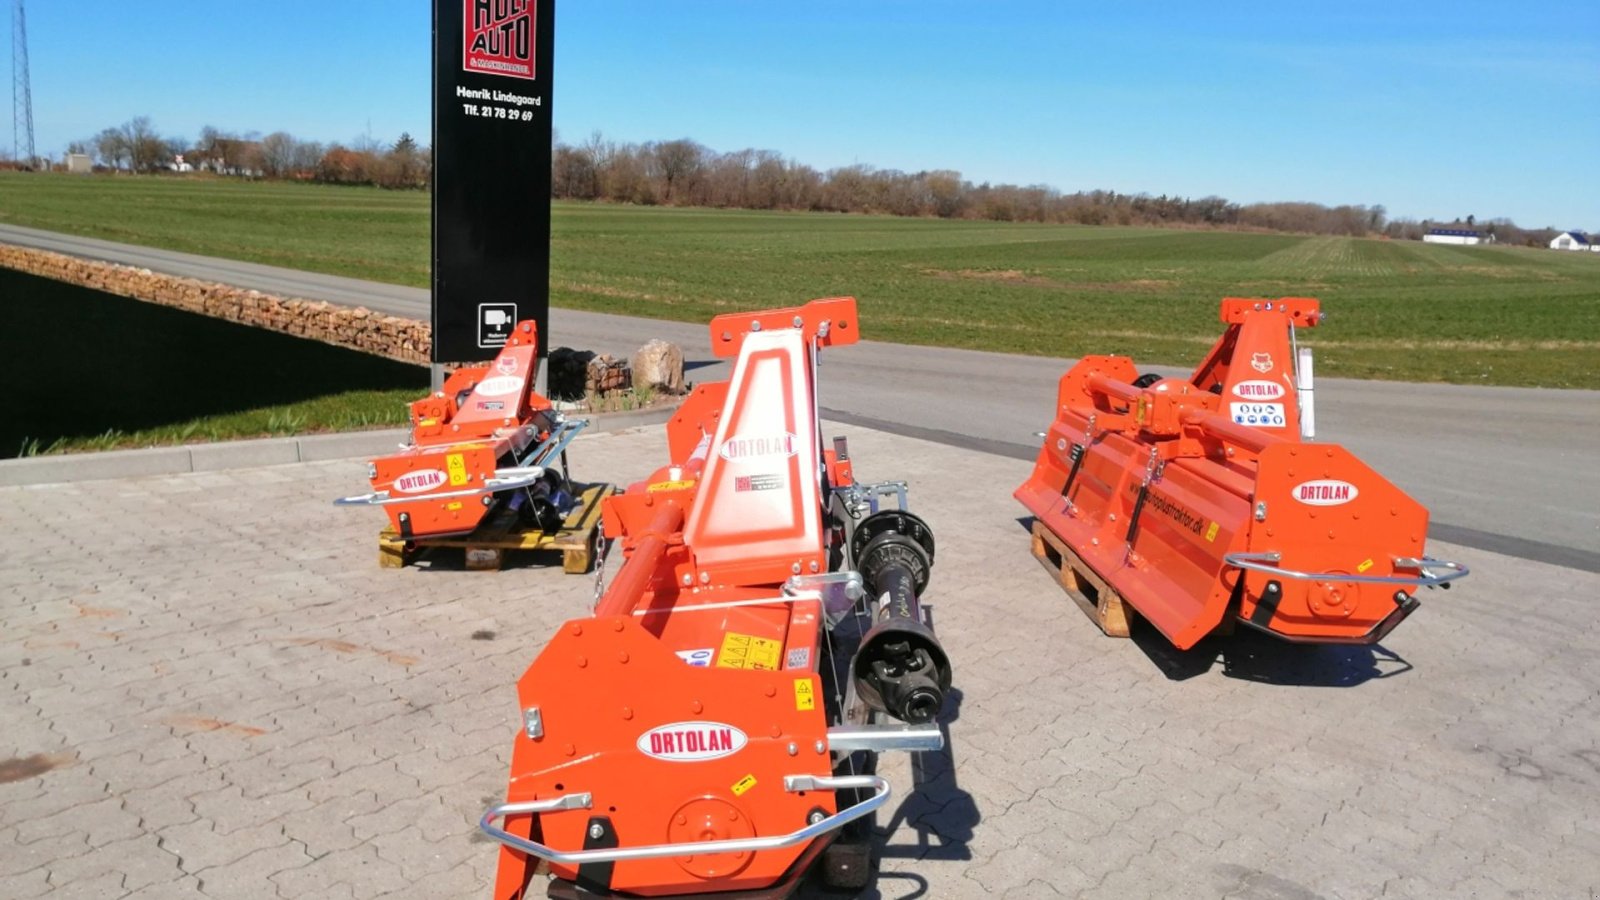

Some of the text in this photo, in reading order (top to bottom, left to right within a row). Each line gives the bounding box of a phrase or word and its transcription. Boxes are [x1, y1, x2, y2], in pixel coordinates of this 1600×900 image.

[470, 14, 530, 60] AUTO
[456, 85, 491, 100] Henrik
[463, 104, 533, 122] Tlf. 21 78 29 69
[1239, 384, 1279, 396] ORTOLAN
[728, 435, 793, 459] ORTOLAN
[399, 471, 441, 490] ORTOLAN
[1300, 485, 1350, 500] ORTOLAN
[649, 728, 733, 755] ORTOLAN
